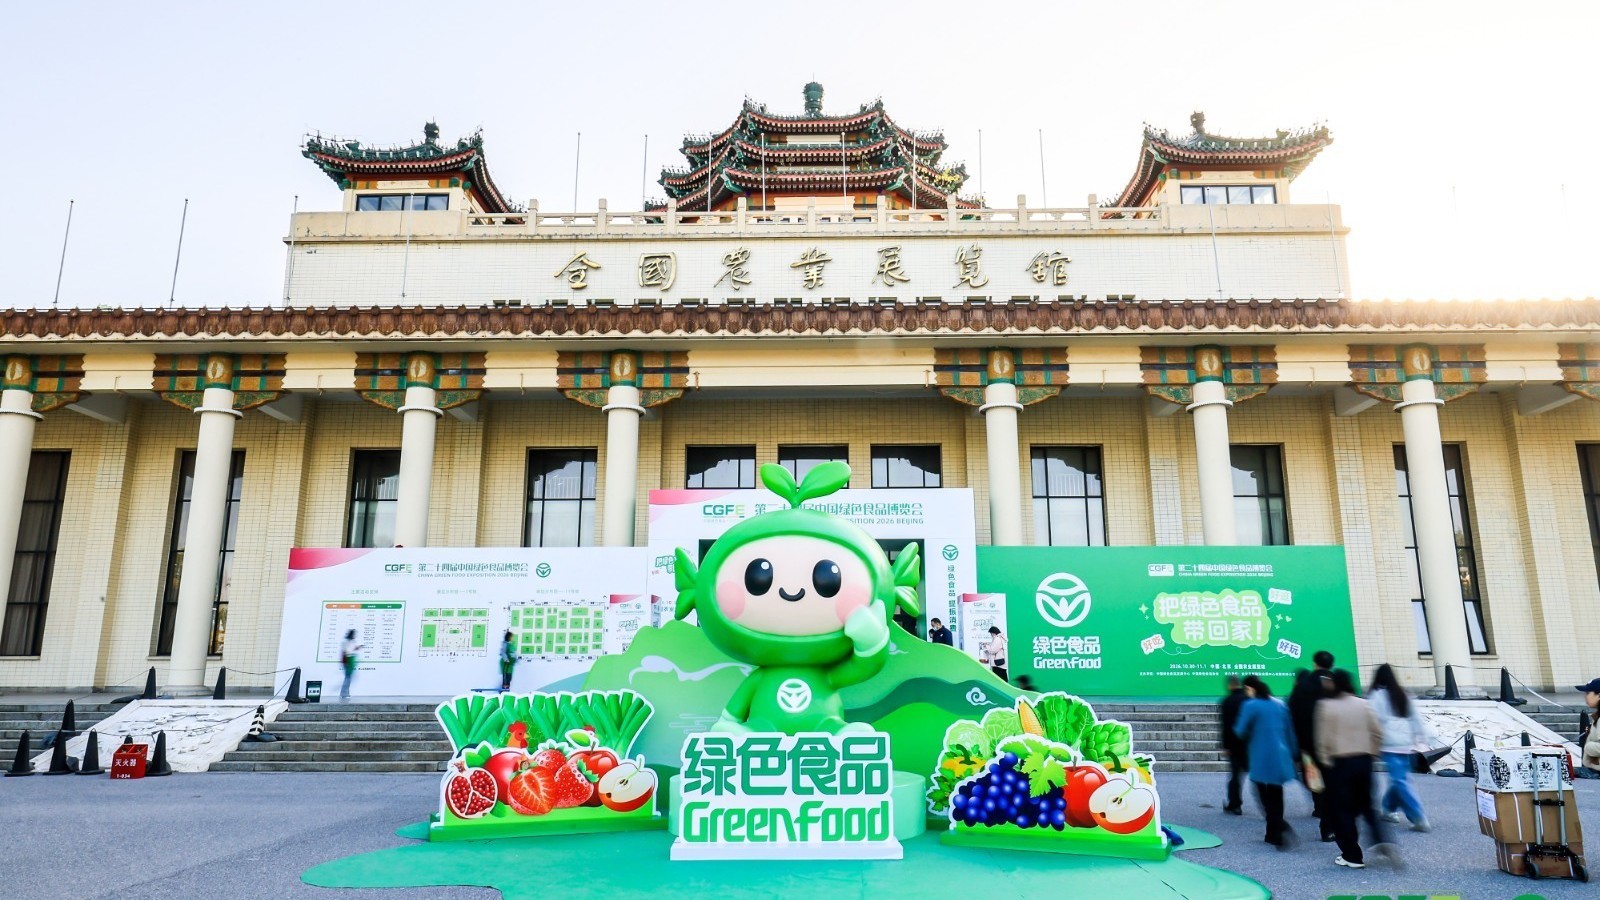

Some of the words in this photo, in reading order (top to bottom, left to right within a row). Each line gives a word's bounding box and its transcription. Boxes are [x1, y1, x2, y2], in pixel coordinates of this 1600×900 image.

[703, 504, 745, 516] CGFE
[876, 517, 895, 525] 2026
[897, 517, 924, 526] BEIJING
[384, 563, 413, 572] CGFE
[418, 562, 529, 573] 第二十四届中国绿色食品博览会
[948, 564, 956, 597] 绿色食品
[1159, 595, 1262, 618] 把绿色食品
[1032, 635, 1101, 655] 绿色食品
[1143, 635, 1163, 652] 好吃
[1278, 640, 1299, 656] 好玩
[114, 758, 137, 767] 灭火器
[684, 736, 889, 796] 绿色食品
